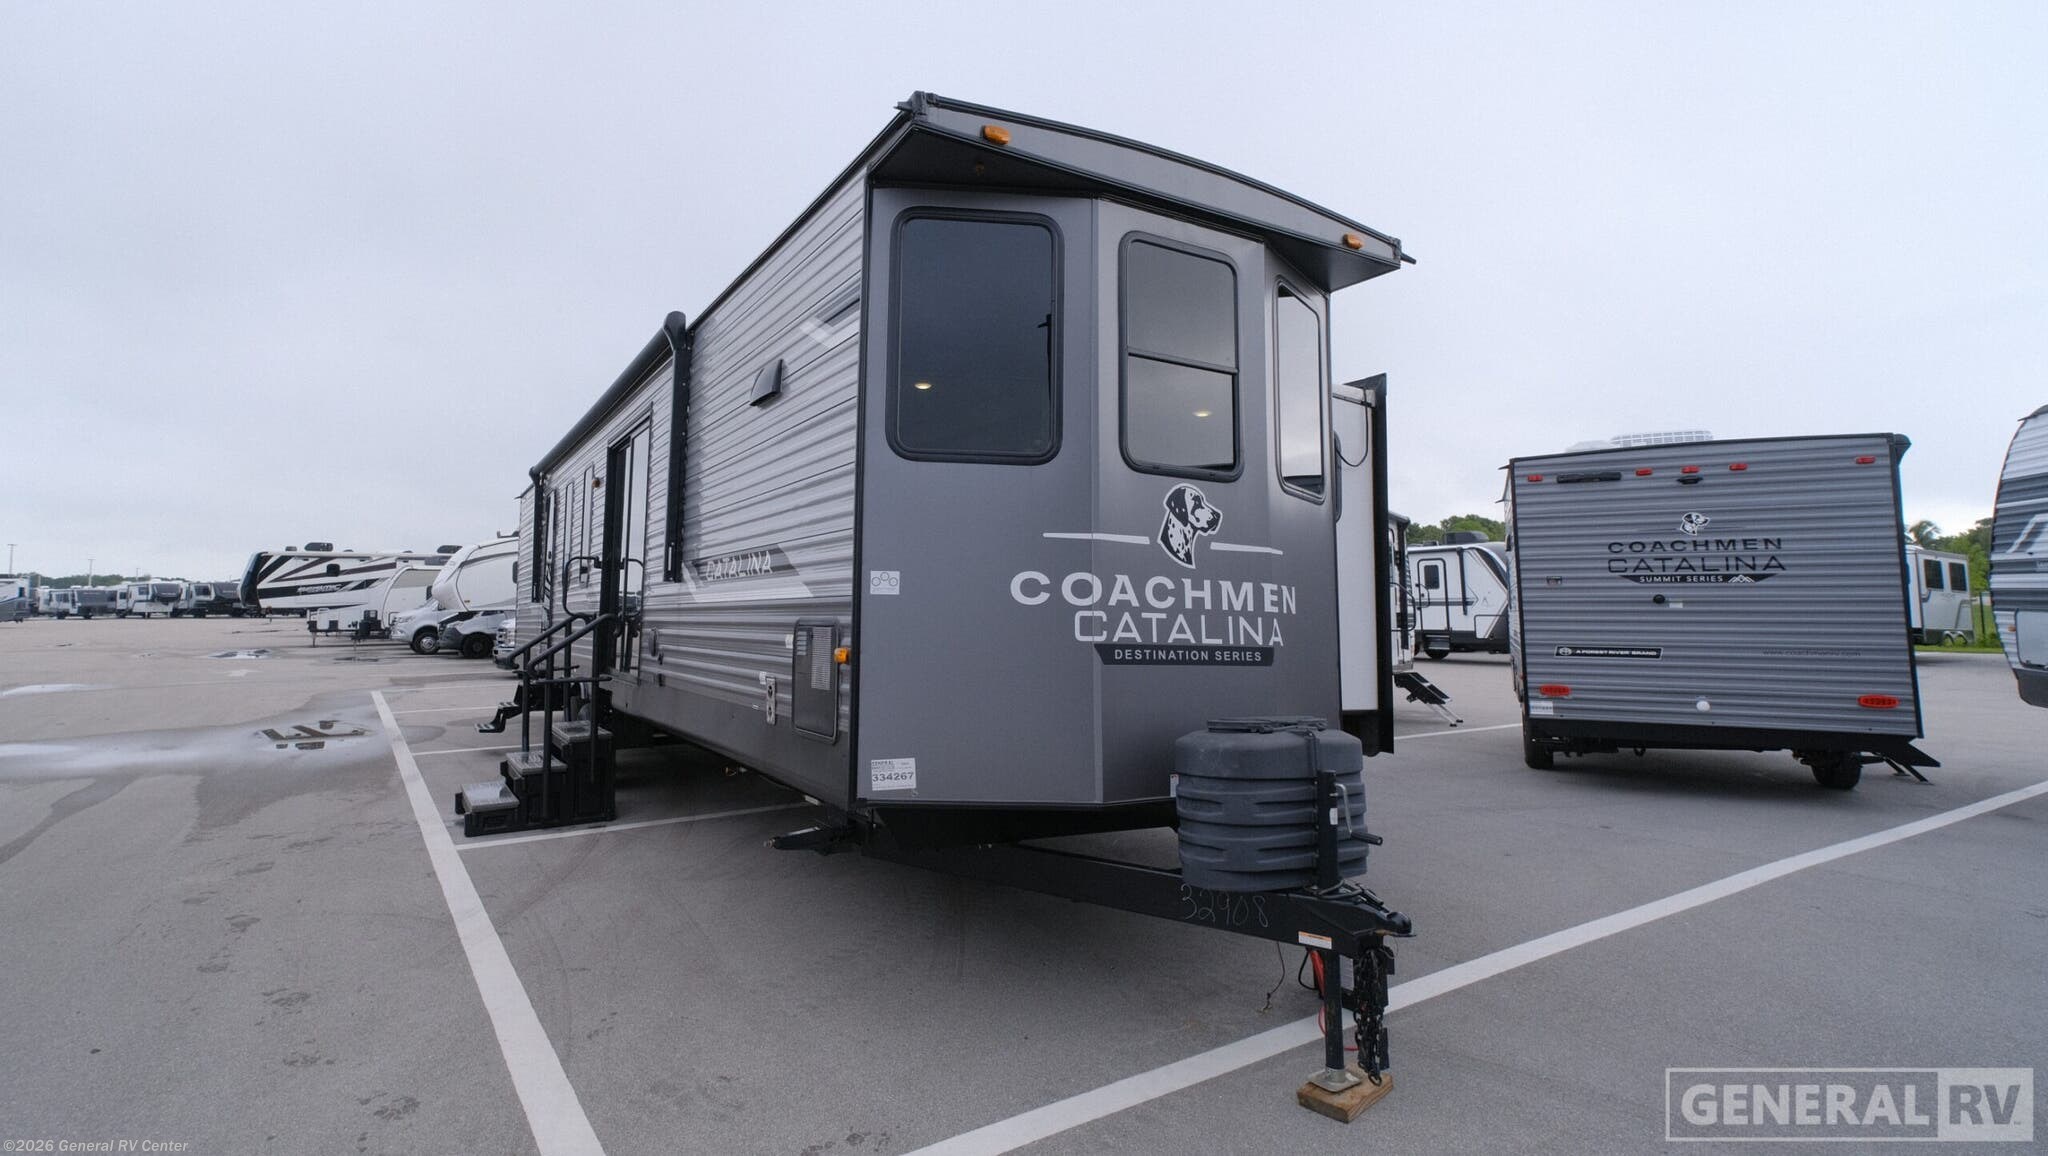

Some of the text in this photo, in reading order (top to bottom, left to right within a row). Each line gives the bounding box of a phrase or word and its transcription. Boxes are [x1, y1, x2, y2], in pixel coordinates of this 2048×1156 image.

[1608, 538, 1783, 553] COACHMEN
[706, 551, 773, 581] CATALINA
[1608, 556, 1787, 573] CATALINA
[1640, 575, 1681, 583] SUMMIT
[1010, 571, 1297, 615] COACHMEN
[1074, 610, 1285, 647] CATALINA
[1114, 649, 1262, 662] DESTINATION SERIES
[873, 772, 914, 782] 334267
